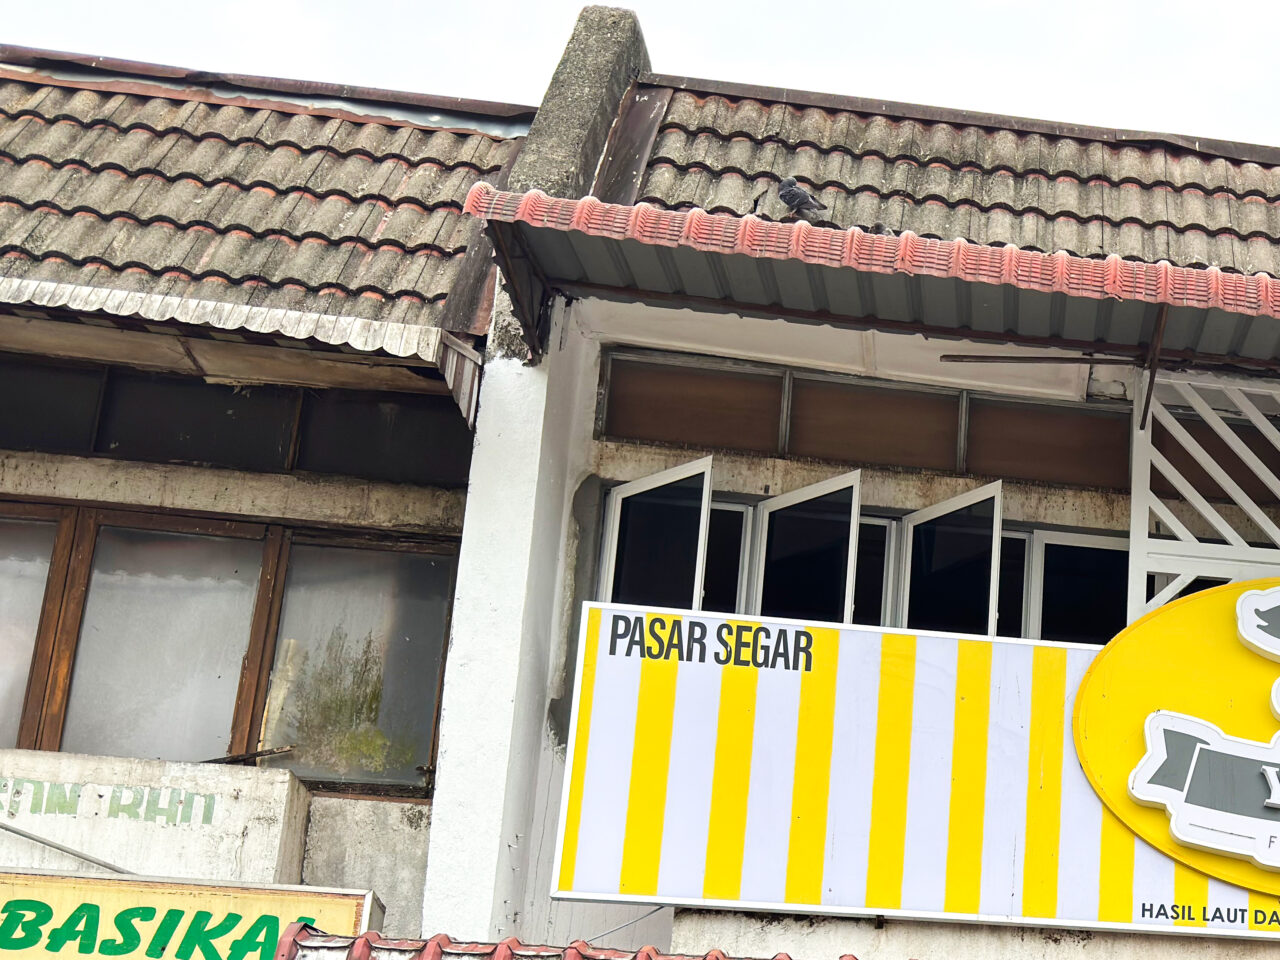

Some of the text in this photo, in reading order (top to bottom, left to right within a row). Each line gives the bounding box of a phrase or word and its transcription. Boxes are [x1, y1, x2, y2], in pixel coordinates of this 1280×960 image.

[609, 614, 813, 672] PASAR SEGAR
[1141, 903, 1196, 921] HASIL
[1202, 906, 1248, 924] LAUT
